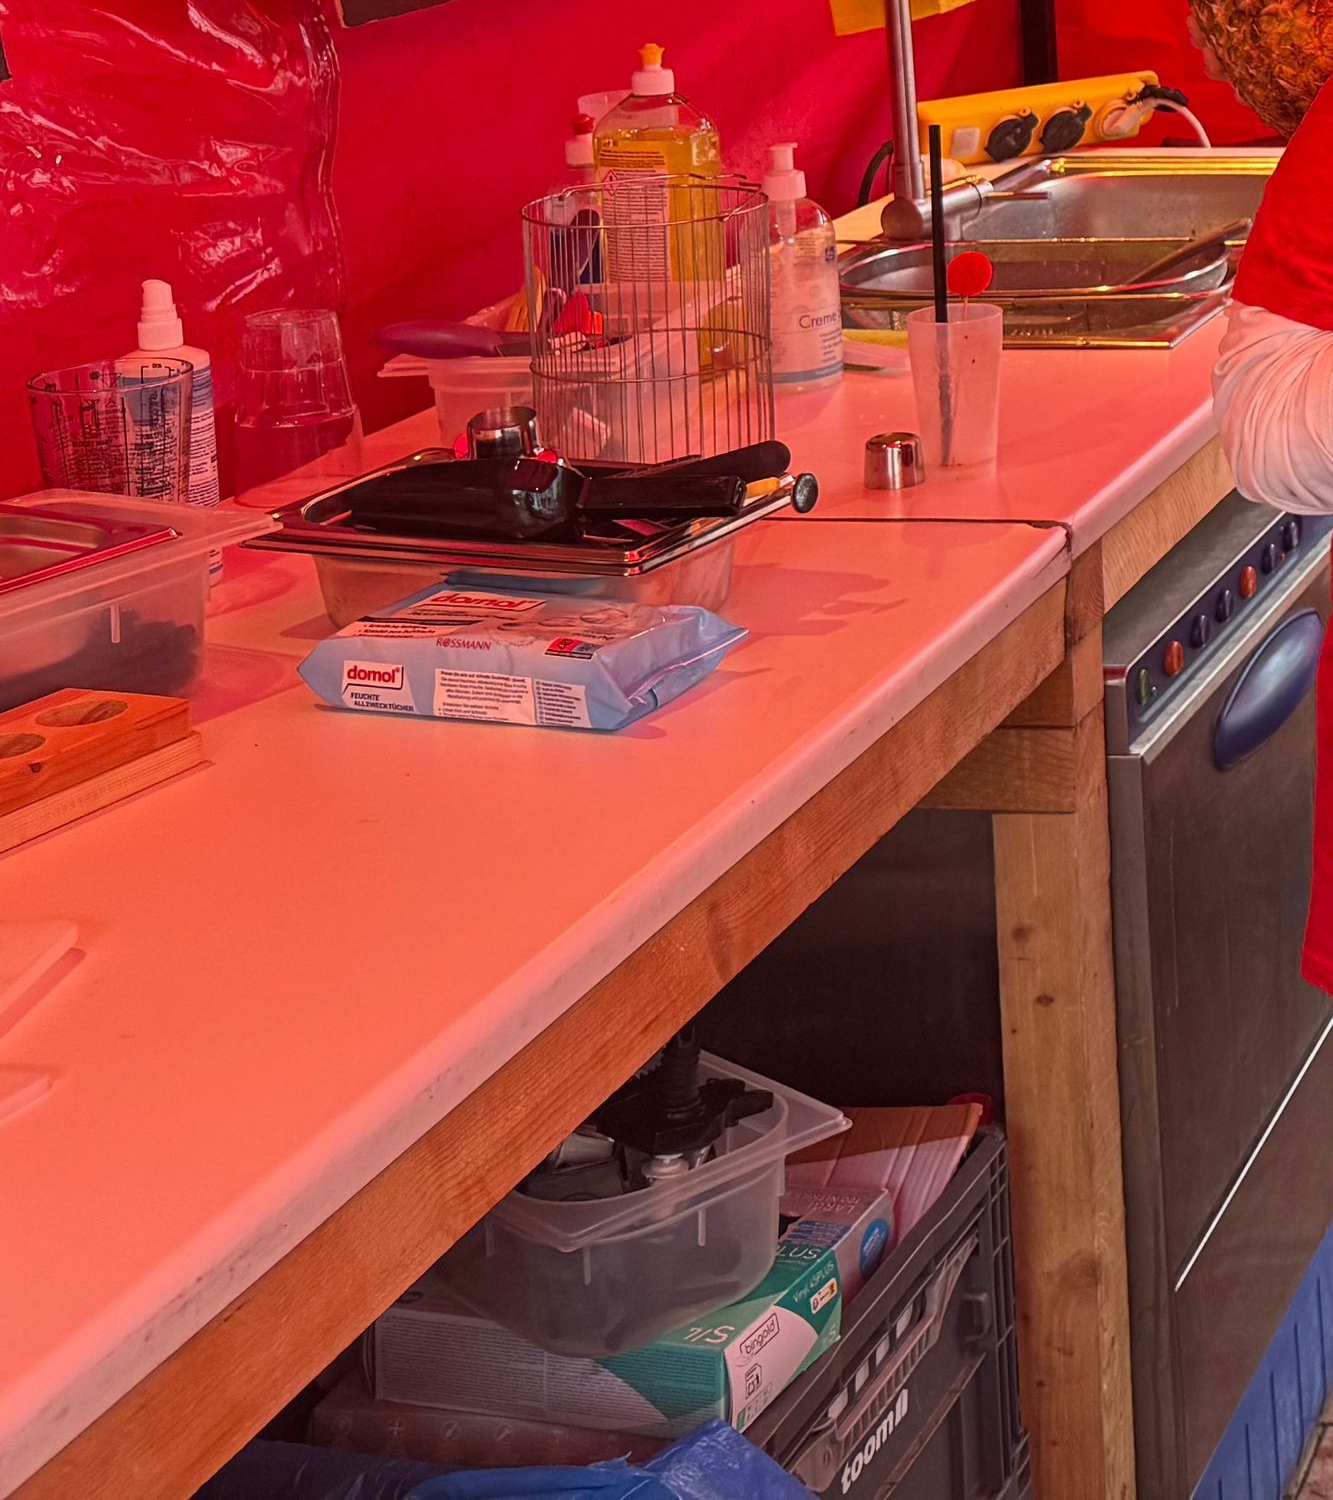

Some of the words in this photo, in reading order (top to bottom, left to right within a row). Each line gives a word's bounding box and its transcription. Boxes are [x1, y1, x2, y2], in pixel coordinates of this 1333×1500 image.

[798, 310, 838, 330] Creme
[346, 665, 396, 684] domol
[350, 691, 380, 702] FEUCHTE
[744, 1319, 776, 1355] bingold
[841, 1409, 894, 1495] toom
